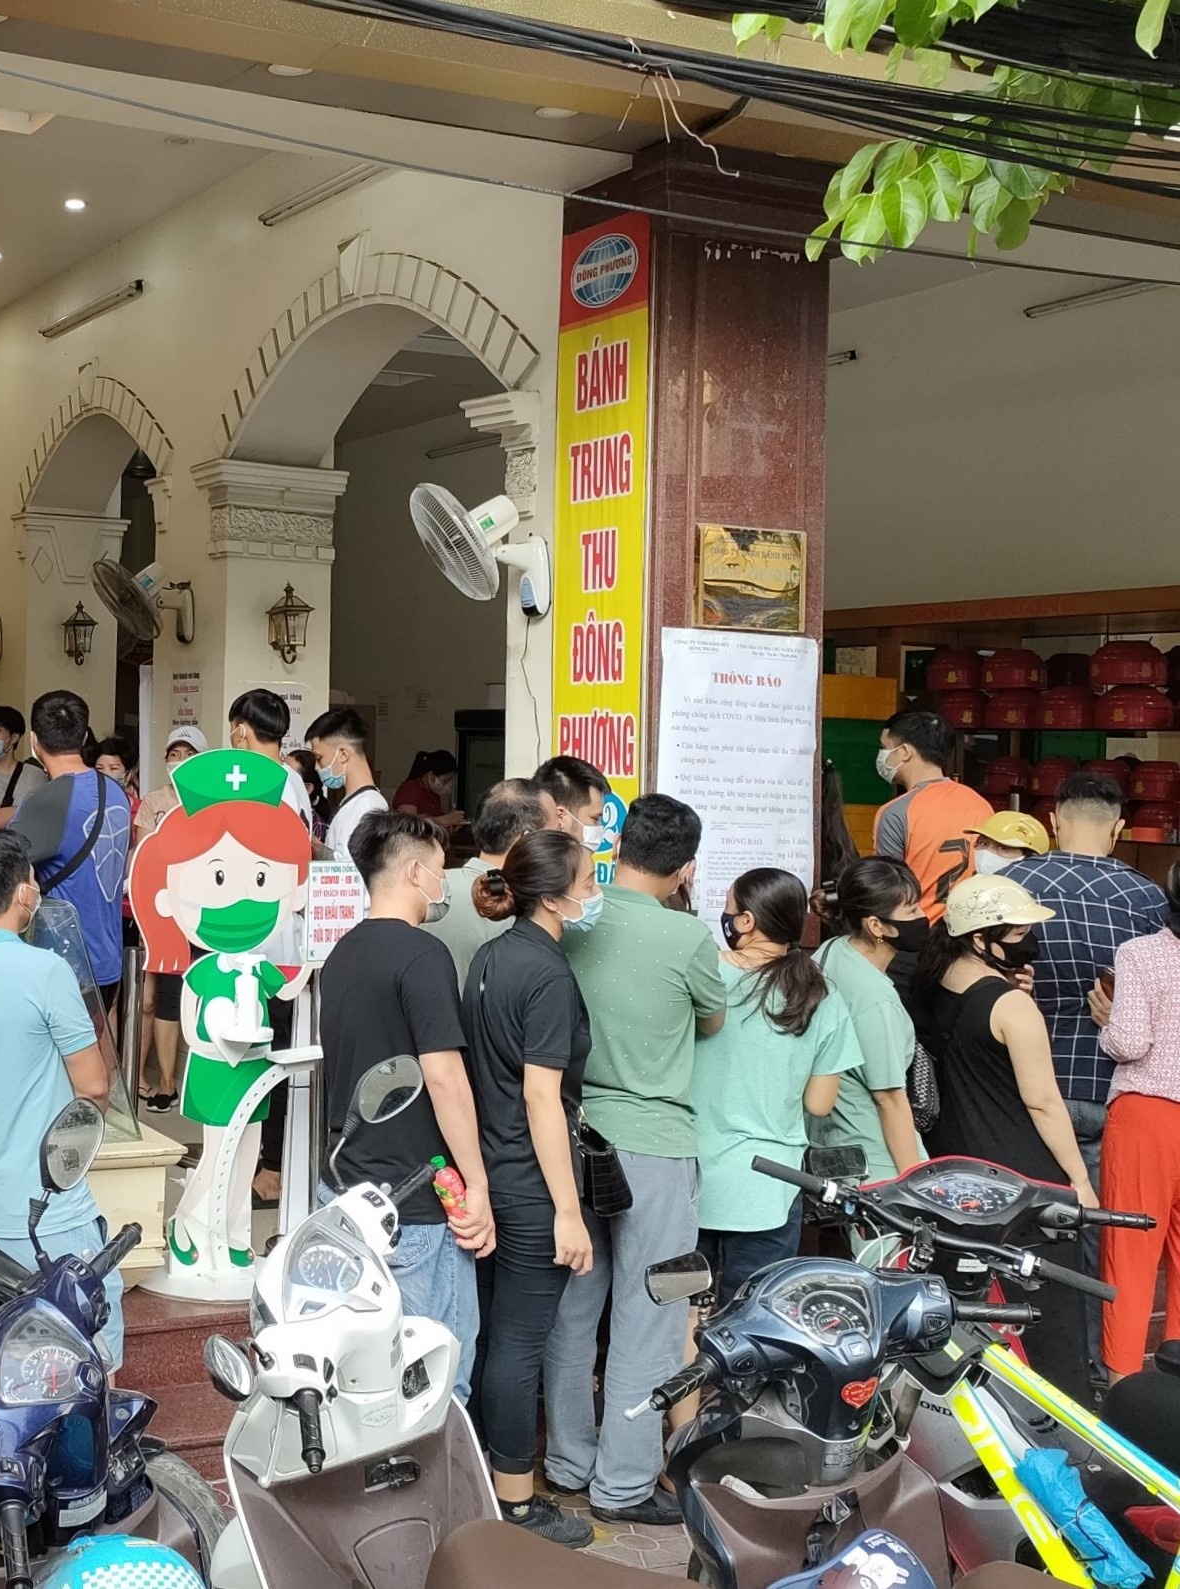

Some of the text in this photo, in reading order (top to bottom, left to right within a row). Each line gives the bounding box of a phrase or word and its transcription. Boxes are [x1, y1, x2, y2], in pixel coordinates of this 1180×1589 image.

[600, 253, 633, 276] PHƯƠNG
[576, 336, 629, 411] BÁNH
[570, 433, 632, 503] TRUNG
[582, 529, 617, 592] THU
[572, 612, 623, 683] ĐÔNG
[712, 671, 782, 688] THÔNG BÁO
[559, 712, 635, 777] PHƯƠNG
[321, 876, 339, 884] COVID
[339, 906, 355, 919] TRANG
[920, 1400, 954, 1418] OND
